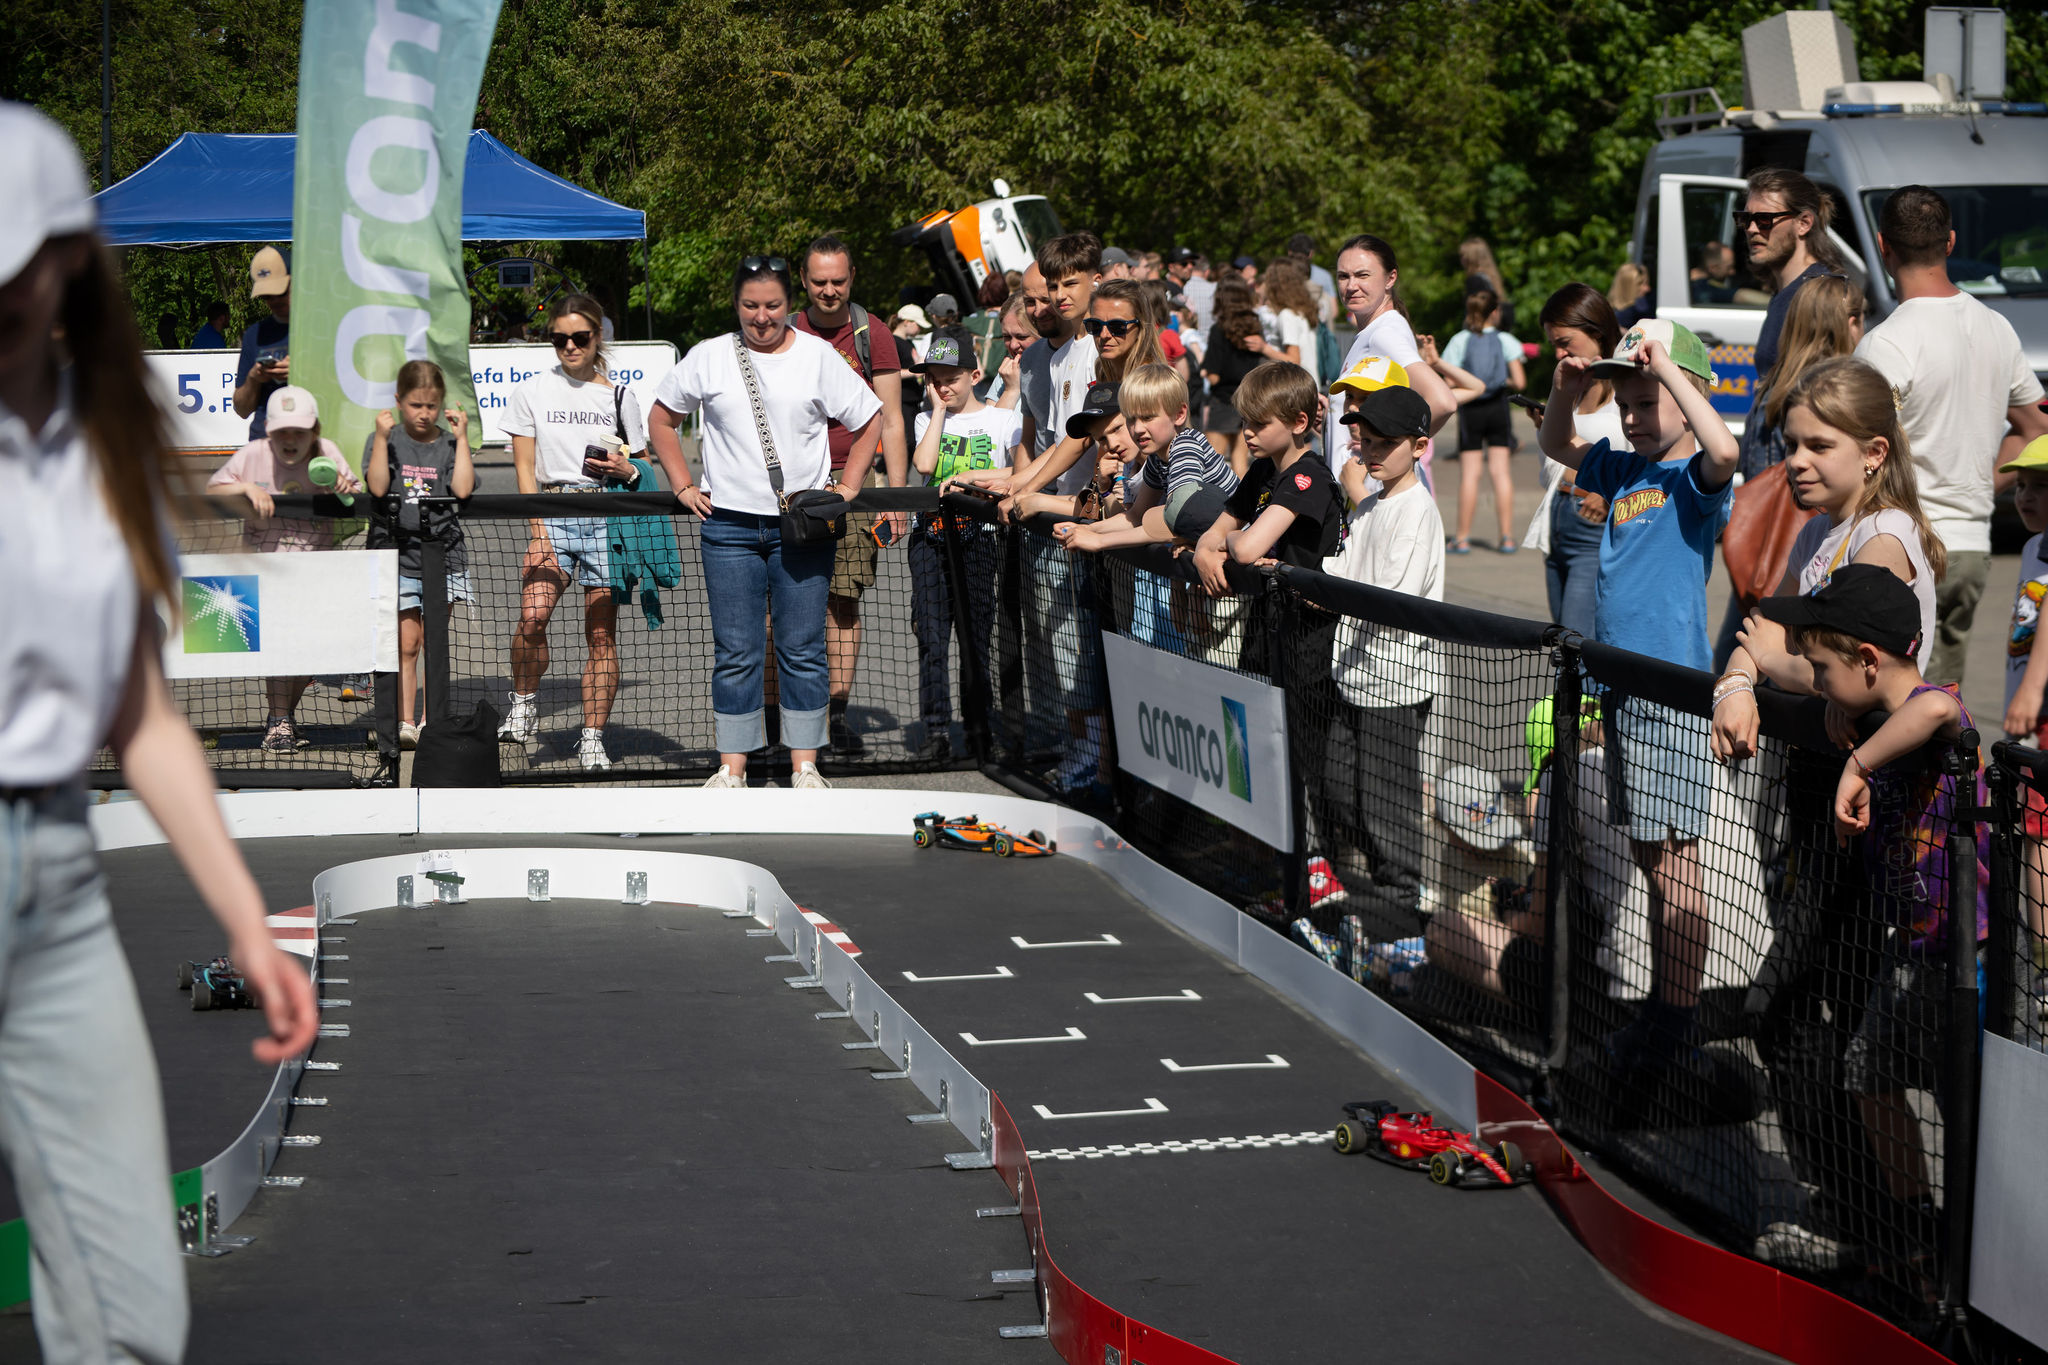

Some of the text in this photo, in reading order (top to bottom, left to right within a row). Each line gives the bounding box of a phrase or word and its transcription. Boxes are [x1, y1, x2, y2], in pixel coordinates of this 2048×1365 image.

[177, 373, 217, 414] 5.
[547, 410, 611, 426] LES JARDINS
[1138, 700, 1224, 790] aramco
